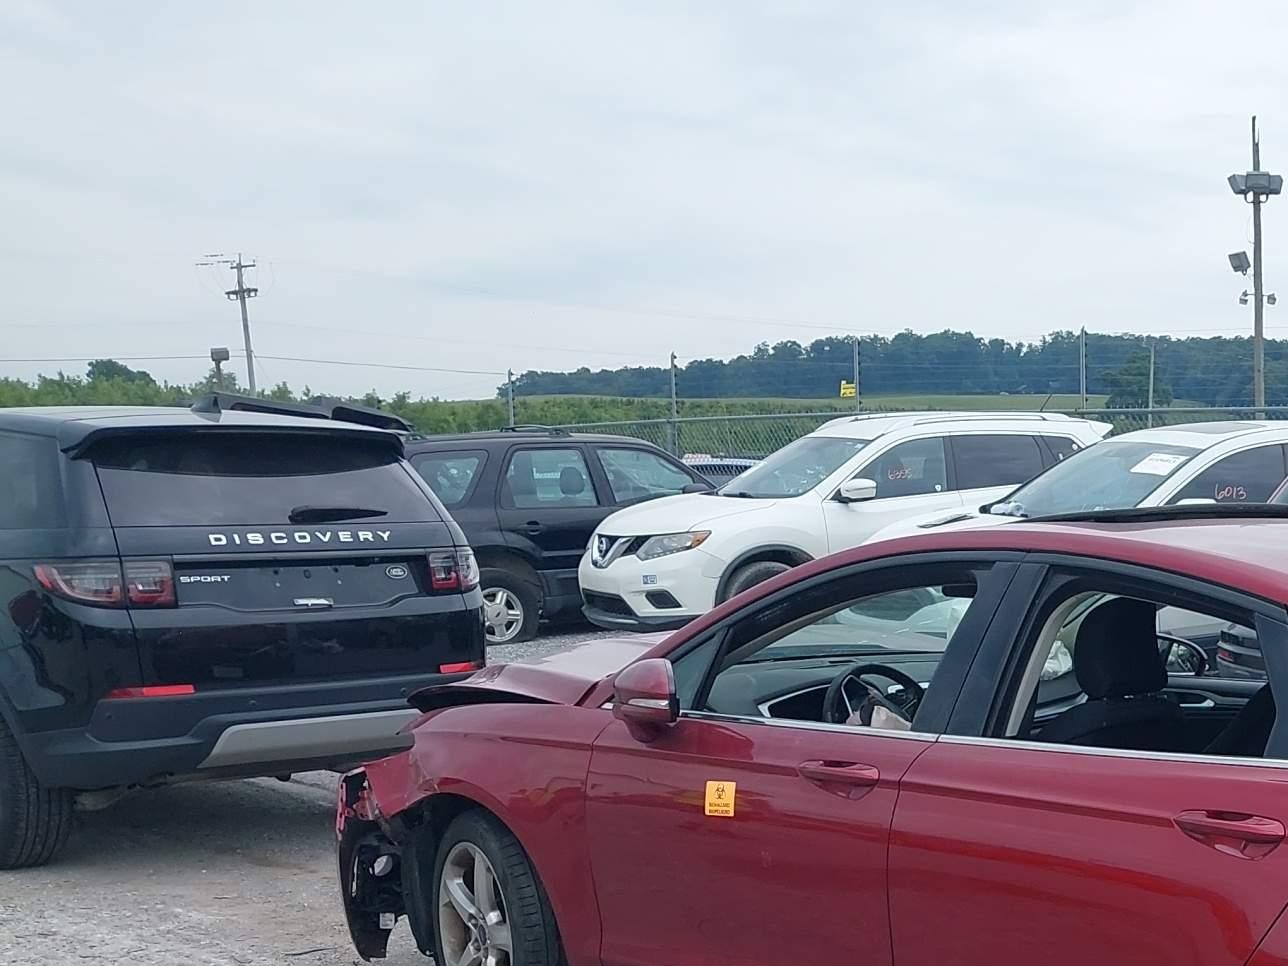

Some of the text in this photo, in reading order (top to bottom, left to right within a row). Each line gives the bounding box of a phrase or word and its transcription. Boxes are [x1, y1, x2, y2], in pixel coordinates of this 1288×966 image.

[1214, 483, 1247, 499] 6013
[208, 530, 391, 546] DISCOVERY
[179, 575, 231, 583] SPORT
